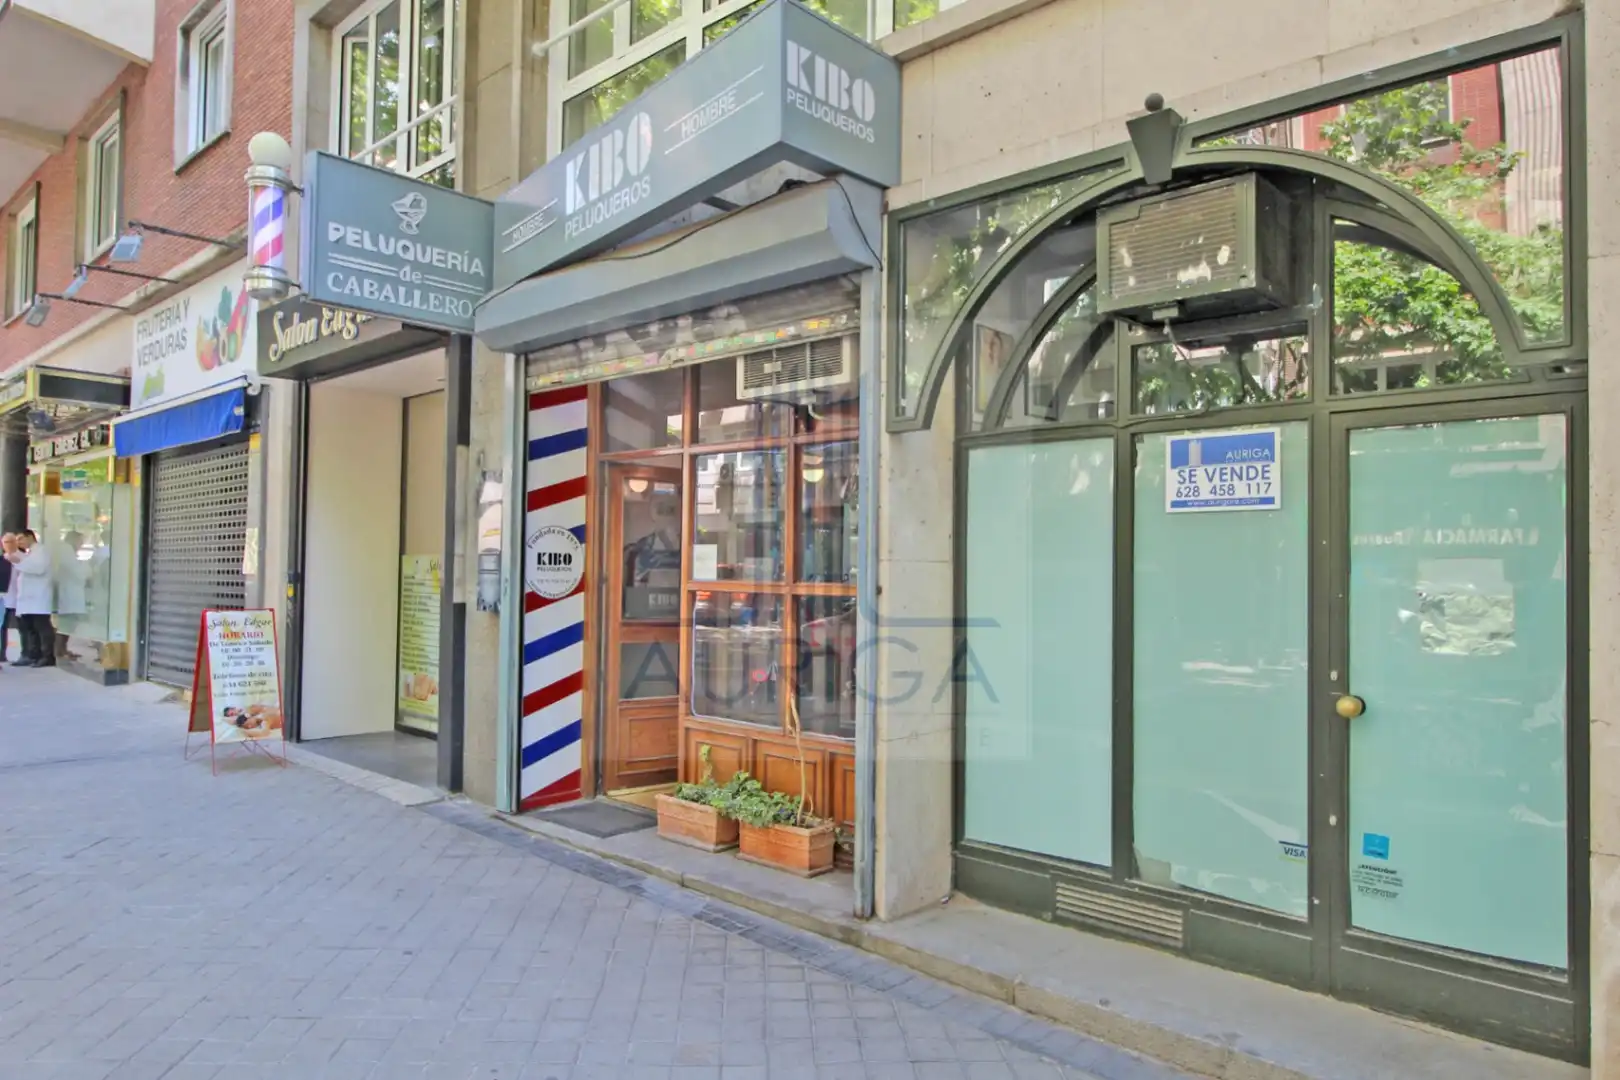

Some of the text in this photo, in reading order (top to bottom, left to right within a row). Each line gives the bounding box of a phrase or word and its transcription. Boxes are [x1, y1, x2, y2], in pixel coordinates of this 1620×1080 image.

[787, 40, 876, 122] KIBO
[681, 89, 738, 140] HOMBRE
[786, 88, 876, 143] PELUQUEROS
[565, 111, 653, 216] KIBO
[512, 212, 545, 242] HOMBRE
[564, 176, 651, 242] PELUQUEROS
[328, 221, 485, 278] PELUQUERÍA
[327, 271, 473, 318] CABALLERO
[399, 265, 422, 283] de
[183, 297, 190, 319] Y
[136, 327, 188, 368] VERDURAS
[269, 307, 376, 361] Salon Edg
[1177, 464, 1271, 484] SE VENDE
[1225, 448, 1271, 460] AURIGA
[1176, 482, 1272, 498] 628 458 117
[537, 552, 573, 566] KIBO
[1283, 846, 1306, 858] VISA
